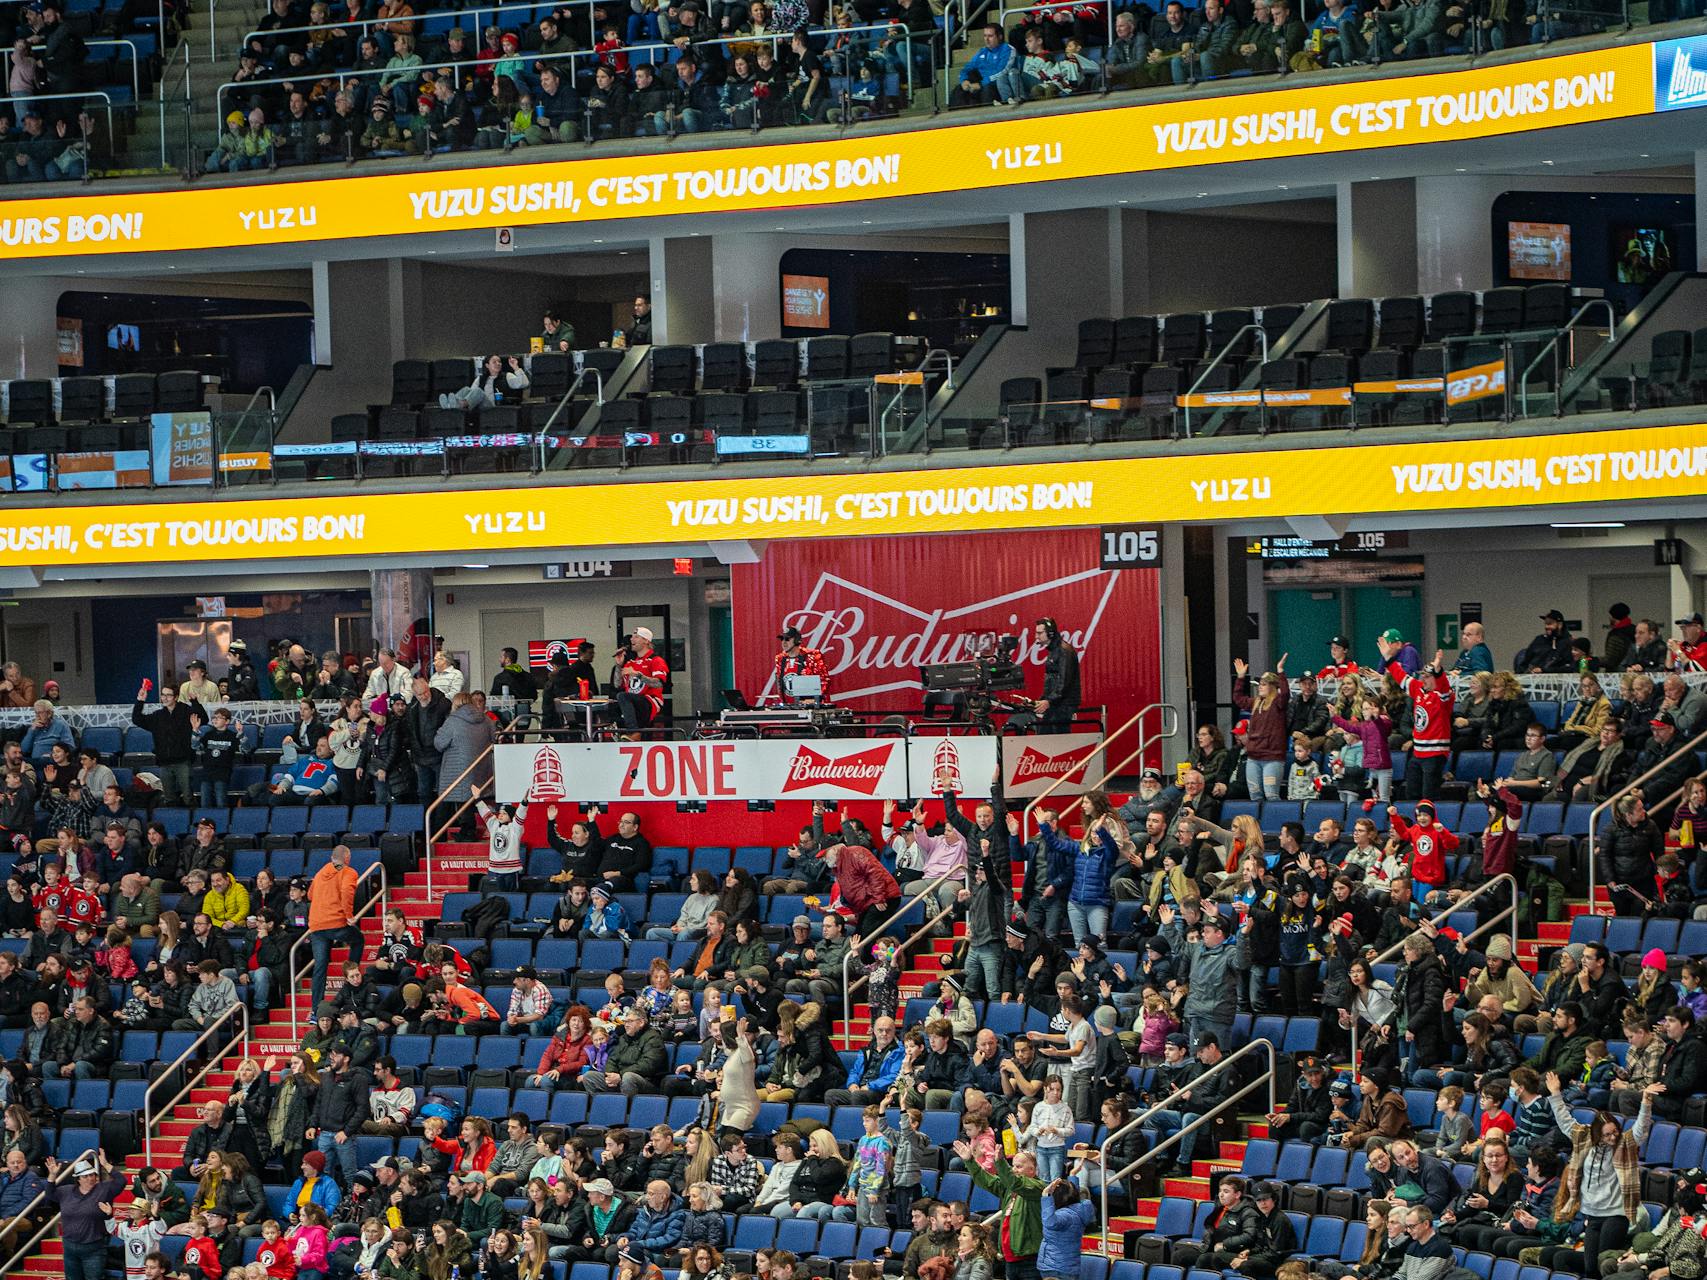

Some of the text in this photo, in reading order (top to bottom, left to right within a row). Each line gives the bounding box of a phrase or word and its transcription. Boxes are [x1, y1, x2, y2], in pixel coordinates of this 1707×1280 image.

[1154, 71, 1614, 153] YUZU SUSHI, C'EST TOUJOURS BON!
[986, 143, 1061, 169] YUZU
[410, 154, 900, 219] YUZU SUSHI, C'EST TOUJOURS BON!
[68, 213, 142, 242] BON!
[240, 207, 316, 229] YUZU
[1392, 463, 1464, 493] YUZU
[1468, 459, 1541, 490] SUSHI,
[1546, 454, 1605, 484] C'EST
[667, 482, 1092, 526] YUZU SUSHI, C'EST TOUJOURS BON!
[1191, 478, 1270, 501] YUZU
[85, 522, 160, 548] C'EST
[166, 517, 297, 546] TOUJOURS
[303, 514, 364, 540] BON!
[465, 512, 545, 533] YUZU
[1103, 531, 1158, 562] 105
[1358, 533, 1385, 548] 105
[619, 744, 737, 797] ZONE
[789, 754, 886, 781] Budweiser
[1283, 924, 1309, 933] MOM
